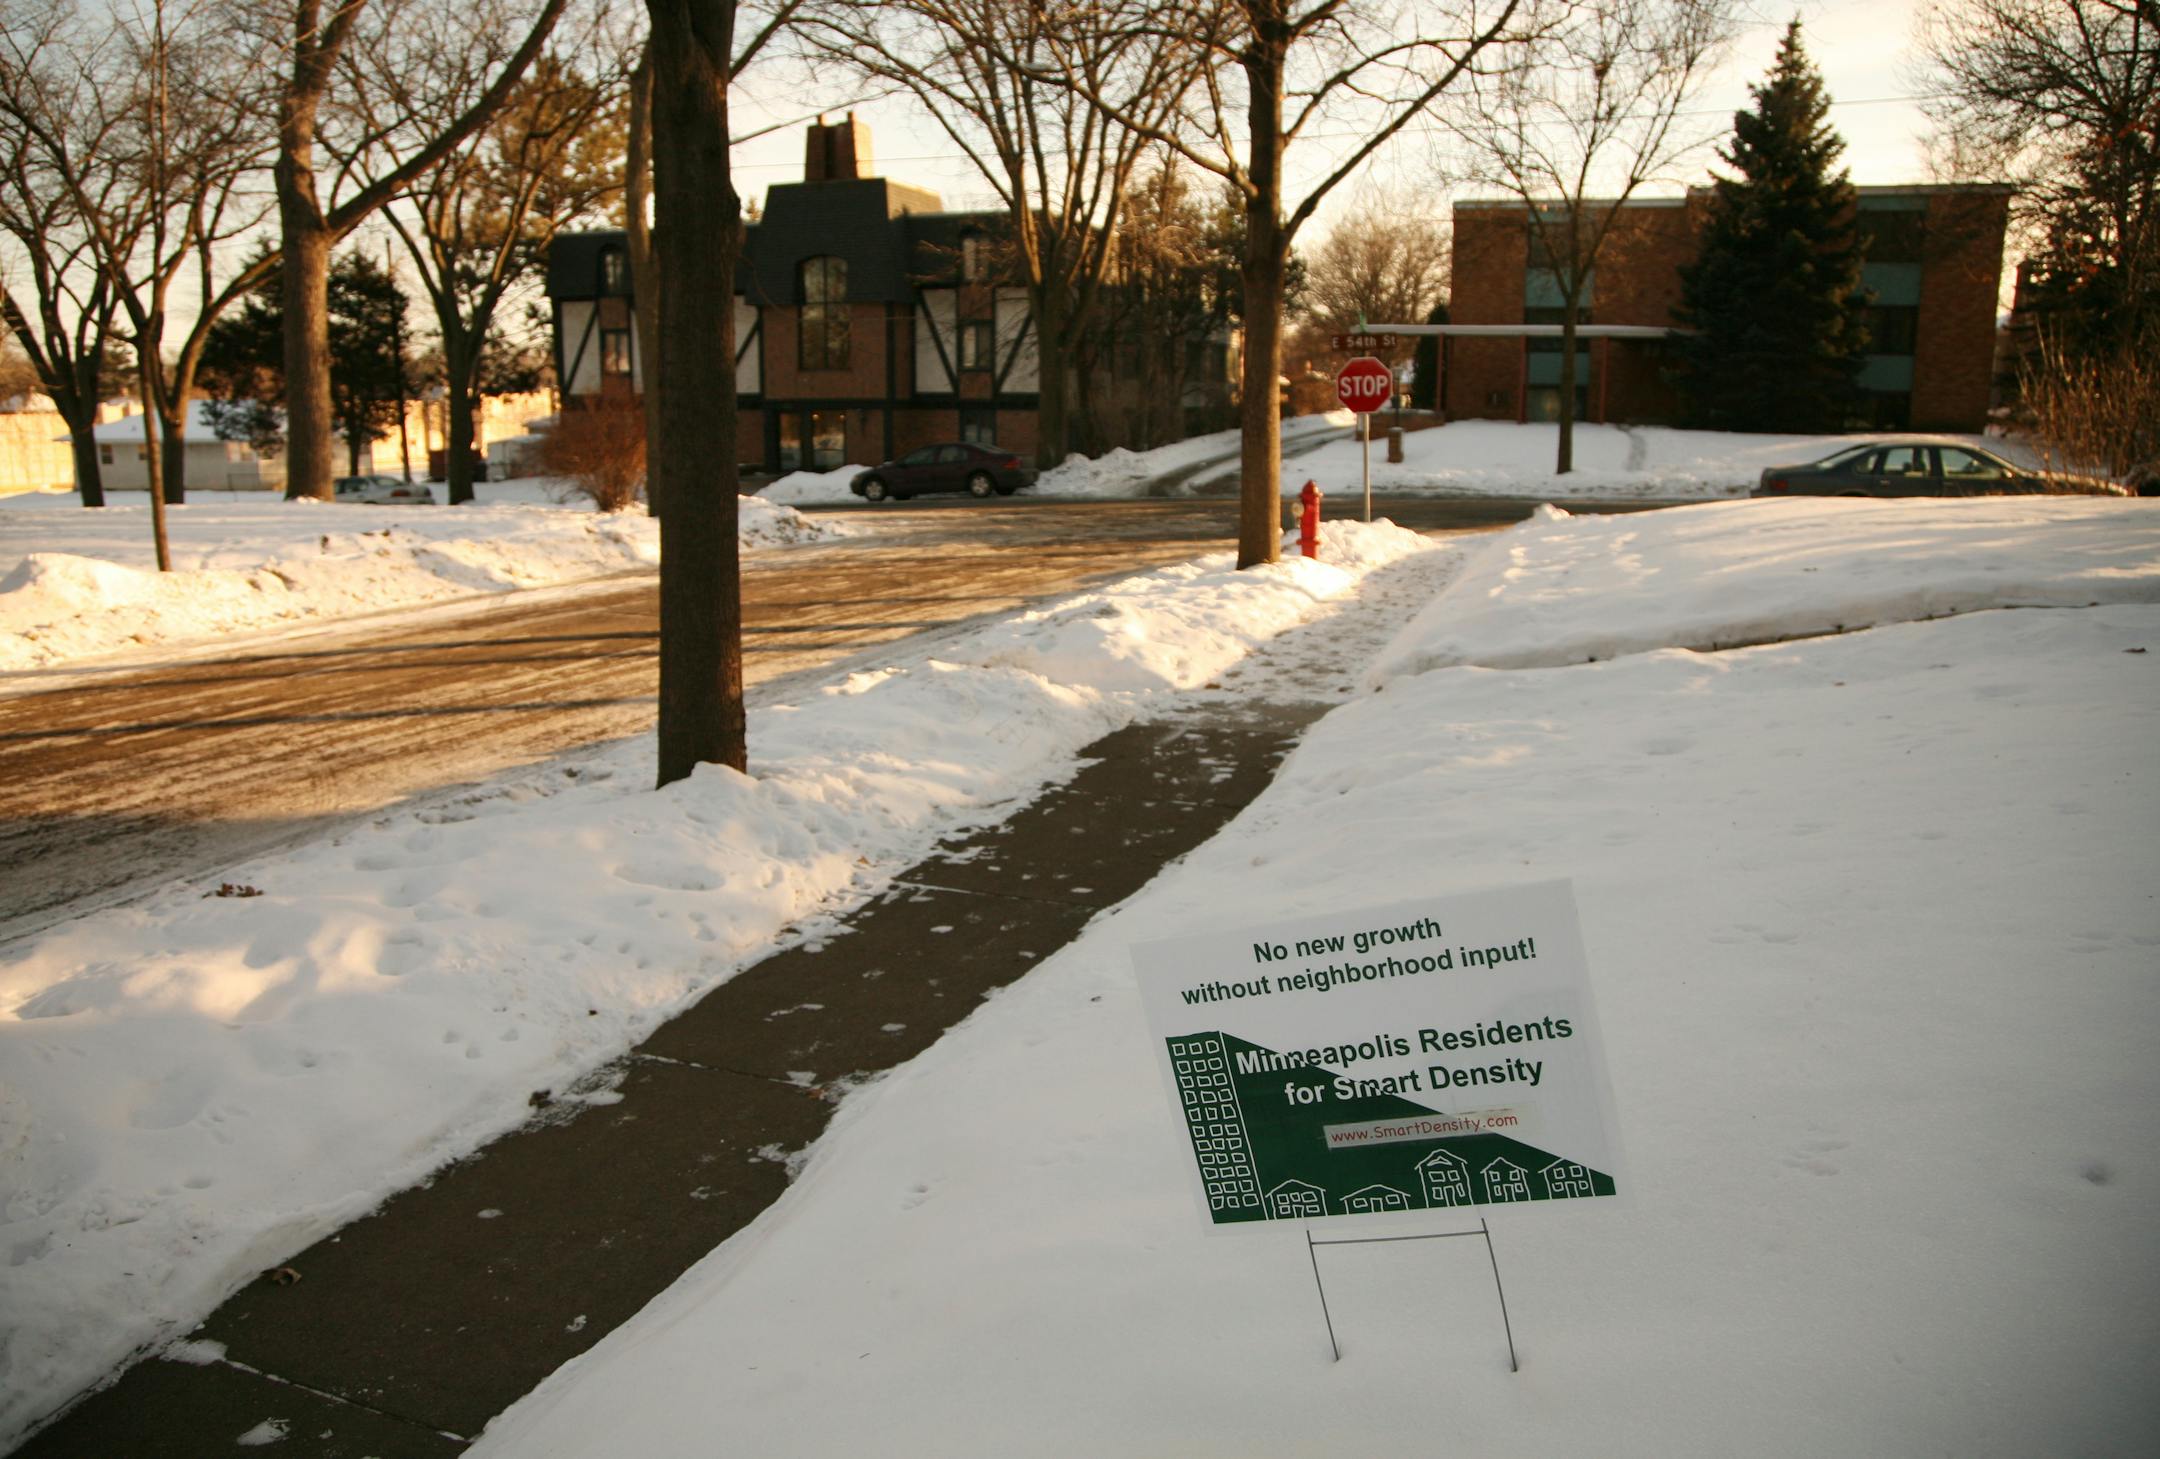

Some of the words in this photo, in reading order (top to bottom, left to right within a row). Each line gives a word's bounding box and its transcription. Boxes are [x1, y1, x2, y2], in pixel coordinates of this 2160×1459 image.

[1332, 336, 1339, 348] E
[1383, 334, 1396, 346] St
[1340, 374, 1388, 397] STOP
[1254, 941, 1288, 963] No
[1295, 936, 1345, 958] new
[1353, 917, 1442, 954] growth
[1181, 975, 1271, 1005] without
[1277, 949, 1453, 992] neighborhood
[1461, 937, 1537, 970] input!
[1236, 1034, 1410, 1075] Minneapolis
[1418, 1015, 1573, 1053] Residents
[1284, 1082, 1325, 1106] for
[1335, 1069, 1422, 1101] Smart
[1430, 1057, 1543, 1090] Density
[1331, 1112, 1519, 1143] www.SmartDensity.com
